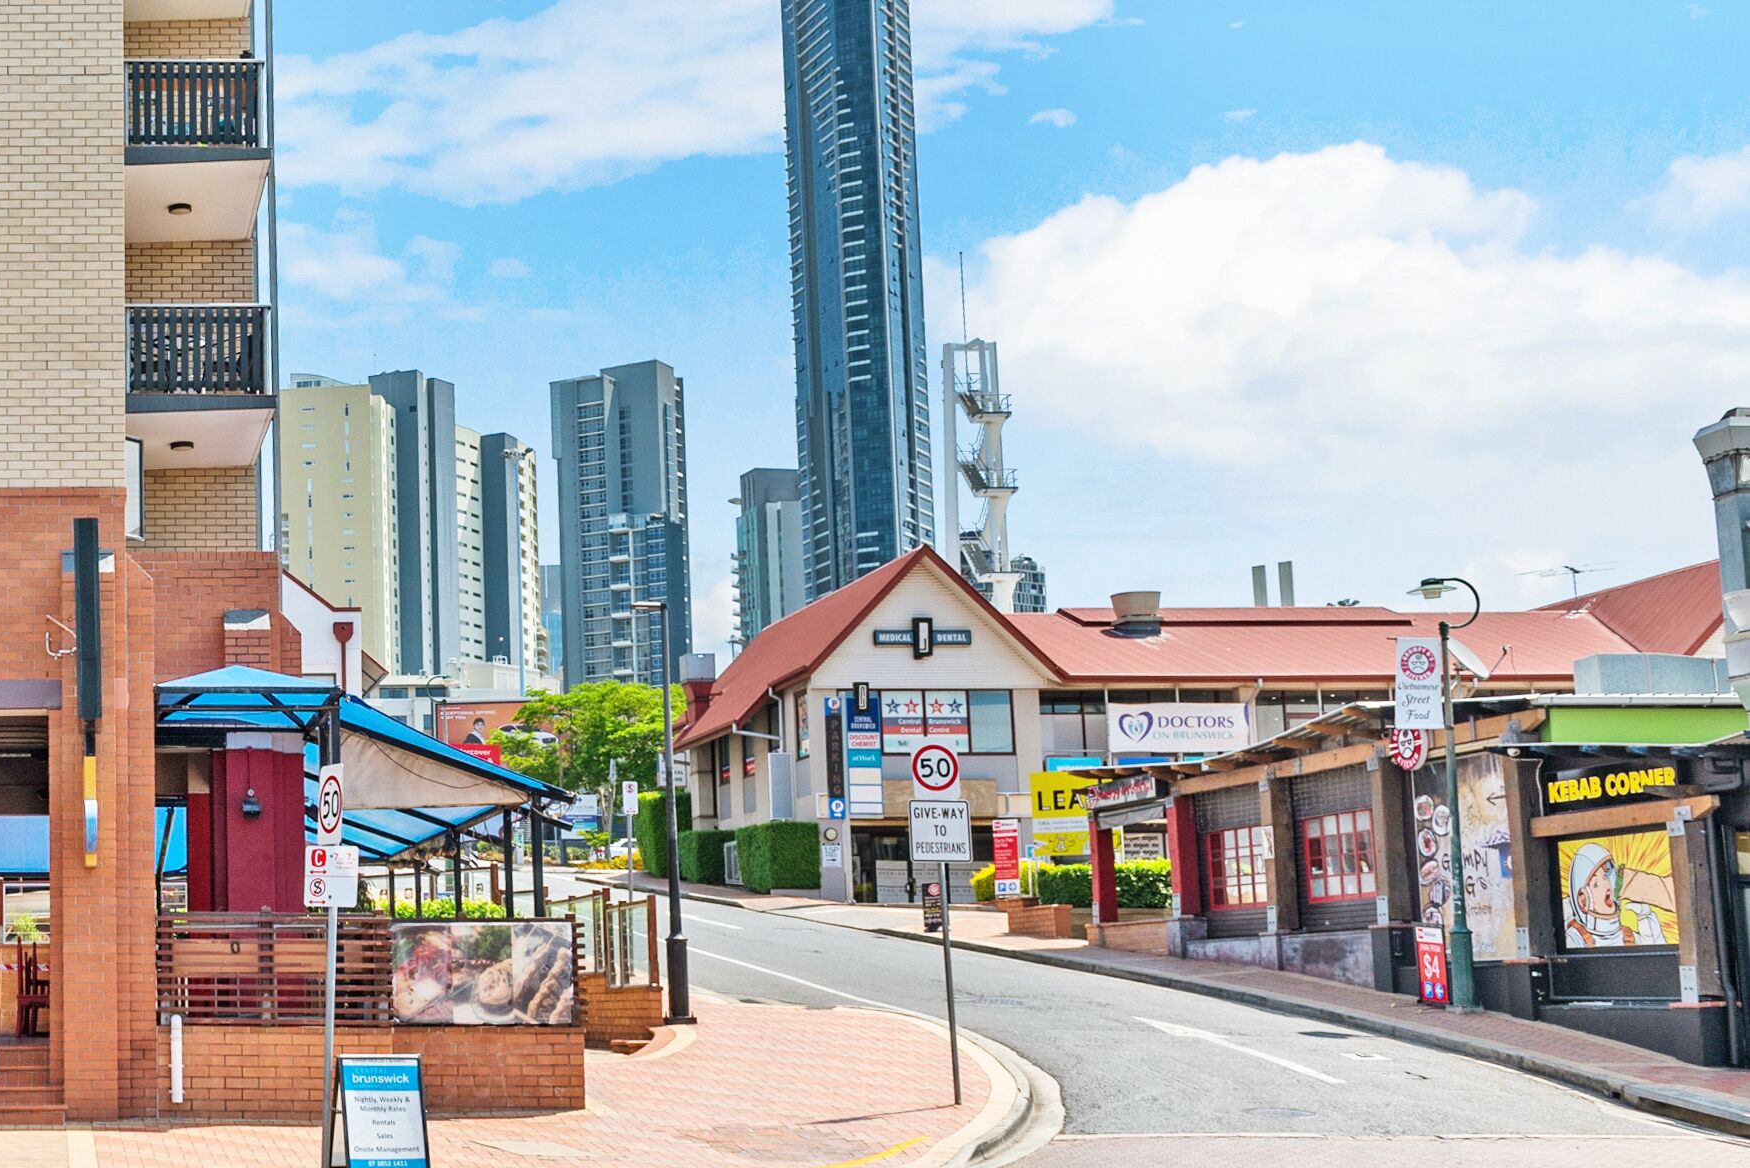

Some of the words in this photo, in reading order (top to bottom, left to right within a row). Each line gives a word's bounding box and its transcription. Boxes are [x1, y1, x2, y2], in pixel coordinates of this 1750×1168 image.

[878, 634, 912, 642] MEDICAL
[936, 634, 967, 642] DENTAL
[1402, 693, 1430, 707] Street
[1158, 715, 1235, 728] DOCTORS
[1406, 709, 1430, 721] Food
[1153, 731, 1169, 740] ON
[1173, 731, 1234, 740] BRUNSWICK
[832, 720, 842, 794] PARKING
[920, 758, 951, 778] 50
[1548, 776, 1602, 804] KEBAB
[1604, 767, 1676, 797] CORNER
[322, 790, 340, 819] 50
[913, 807, 964, 819] GIVE-WAY
[934, 824, 947, 837] TO
[915, 841, 966, 854] PEDESTRIANS
[1423, 953, 1440, 980] $4
[352, 1073, 410, 1084] brunswick
[354, 1096, 378, 1104] Nightly,
[380, 1096, 403, 1104] Weekly
[376, 1146, 420, 1154] Management
